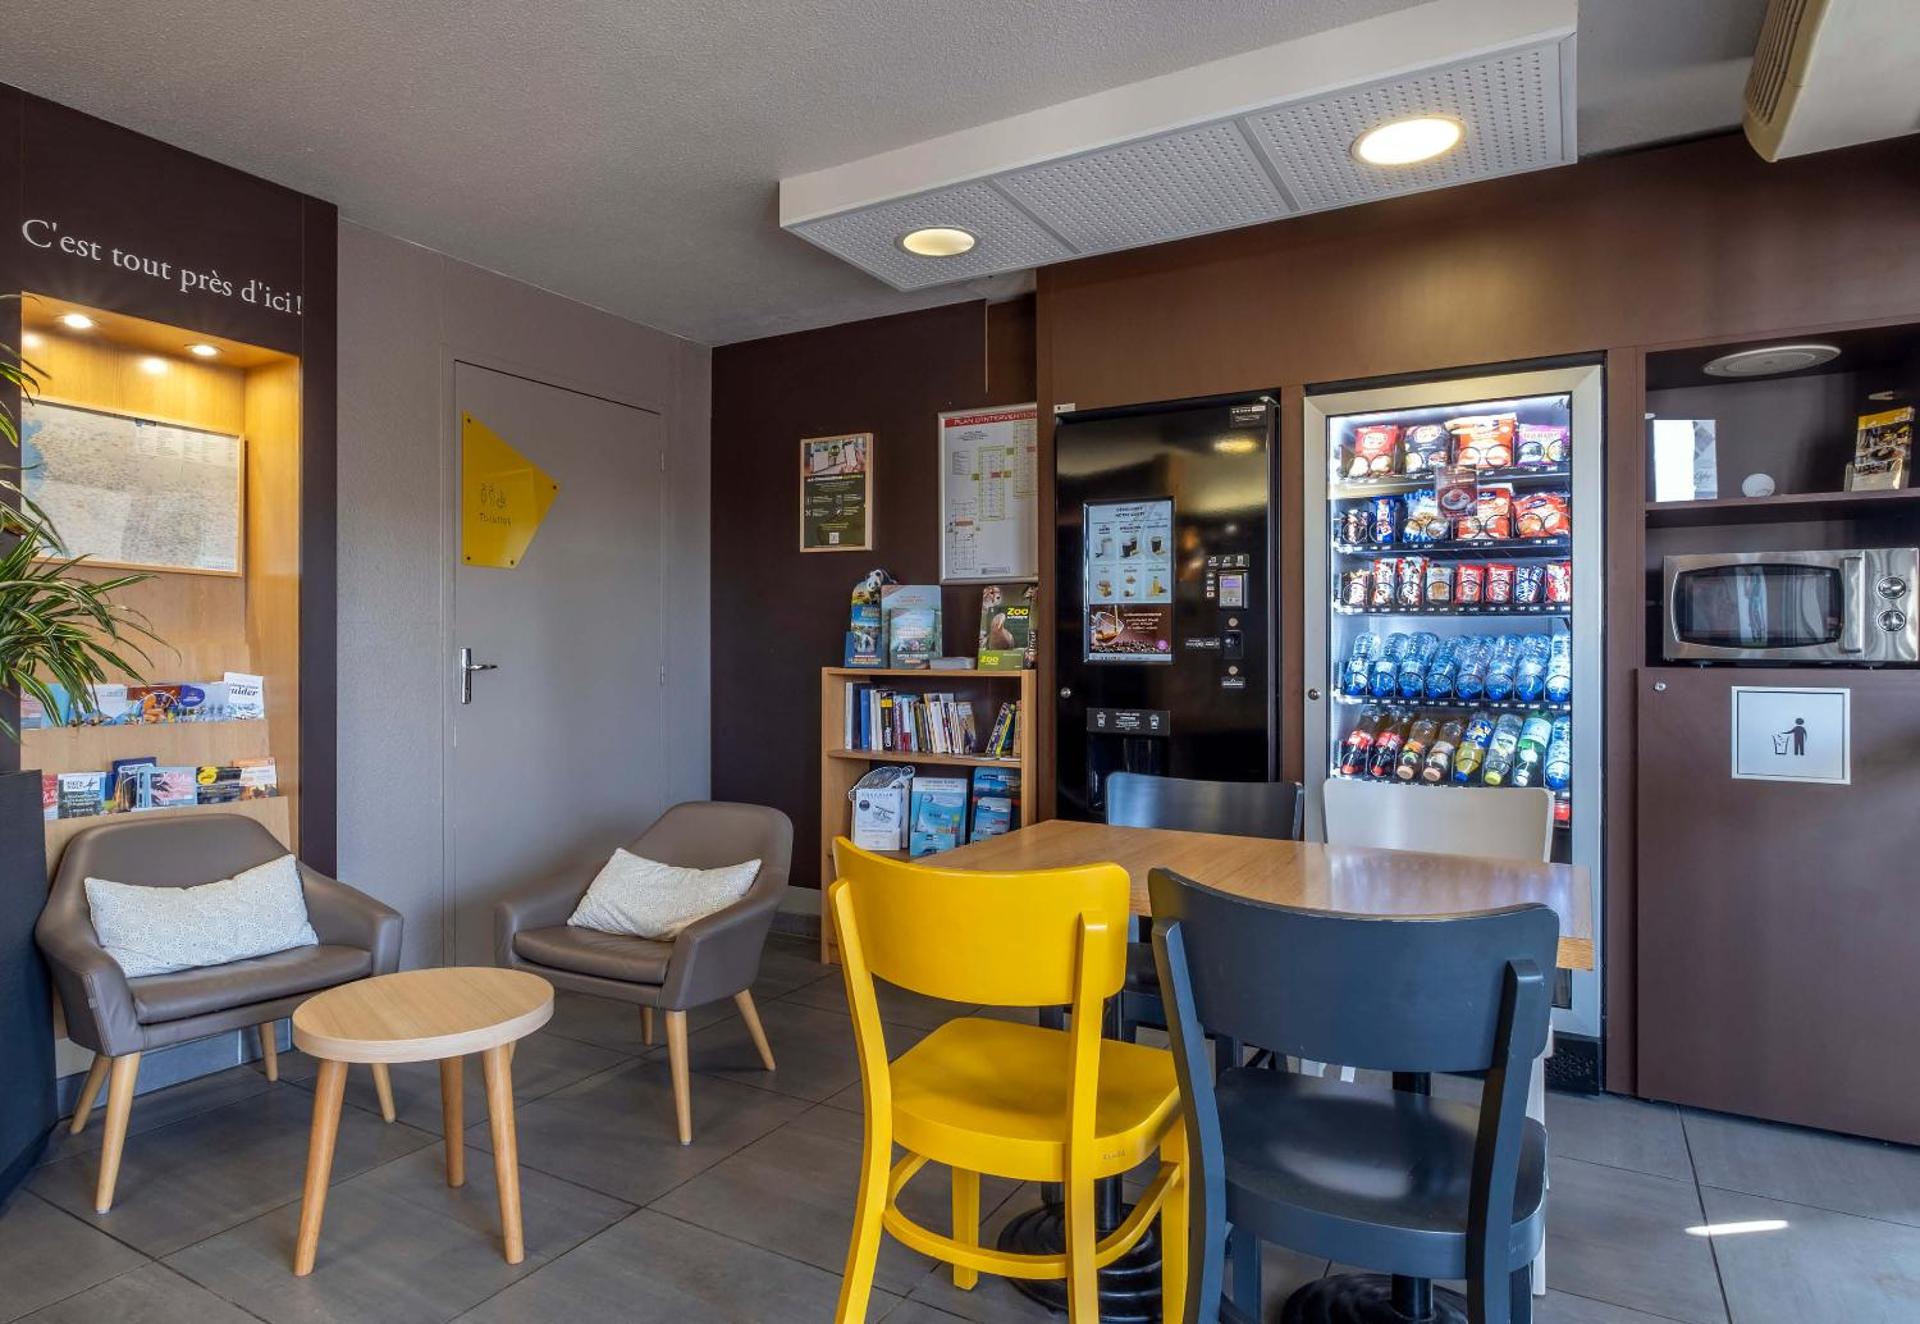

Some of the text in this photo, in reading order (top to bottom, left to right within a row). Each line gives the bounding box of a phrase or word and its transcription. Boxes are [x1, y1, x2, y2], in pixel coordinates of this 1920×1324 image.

[21, 219, 102, 261] C'est
[112, 248, 171, 279] tout
[179, 267, 233, 297] près
